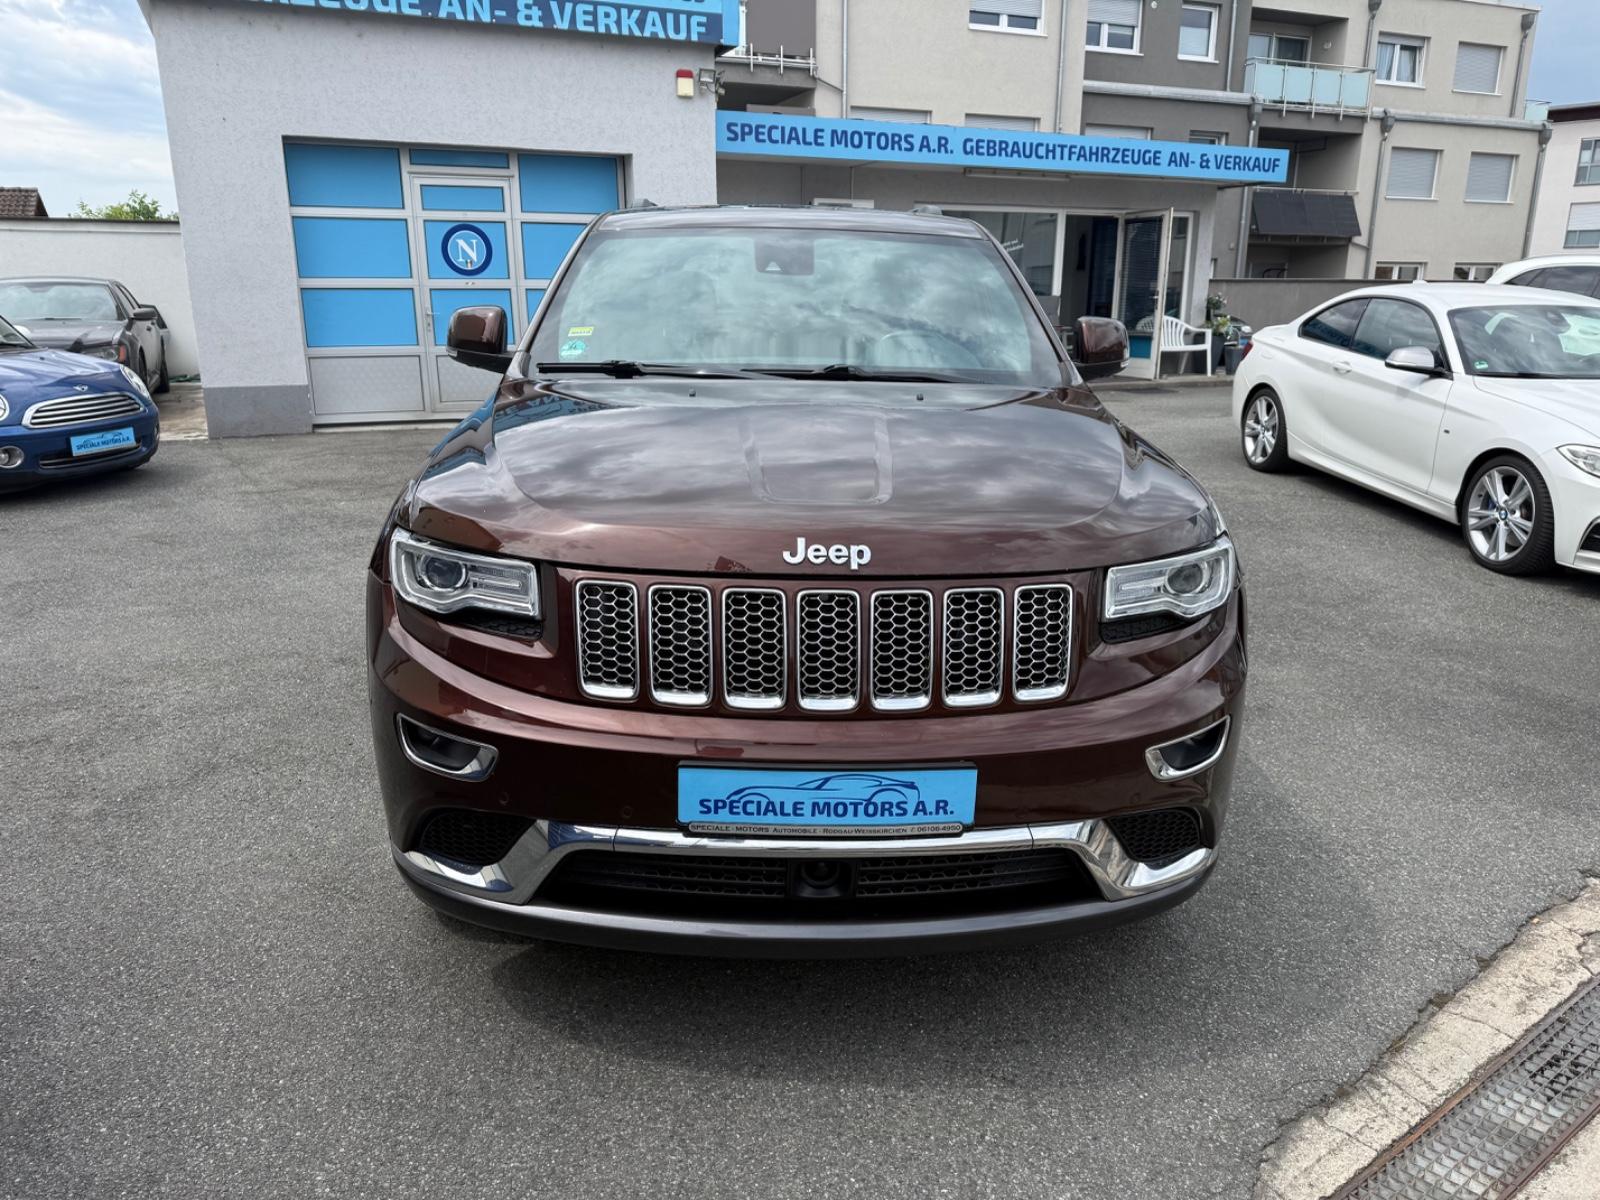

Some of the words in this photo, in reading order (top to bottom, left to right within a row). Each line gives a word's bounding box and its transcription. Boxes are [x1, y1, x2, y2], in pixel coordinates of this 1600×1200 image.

[516, 0, 543, 27] &
[549, 1, 708, 42] VERKAUF
[725, 121, 825, 147] SPECIALE
[830, 128, 915, 152] MOTORS
[918, 134, 954, 154] A.R.
[962, 137, 1162, 167] GEBRAUCHTFAHRZEUGE
[1168, 151, 1196, 168] AN-
[1199, 152, 1211, 169] &
[1214, 154, 1281, 174] VERKAUF
[456, 239, 477, 262] N
[782, 536, 872, 570] Jeep
[698, 798, 805, 818] SPECIALE
[810, 800, 909, 818] MOTORS
[913, 799, 955, 817] A.R.
[690, 824, 732, 832] SPECIALE
[735, 825, 770, 833] MOTORS
